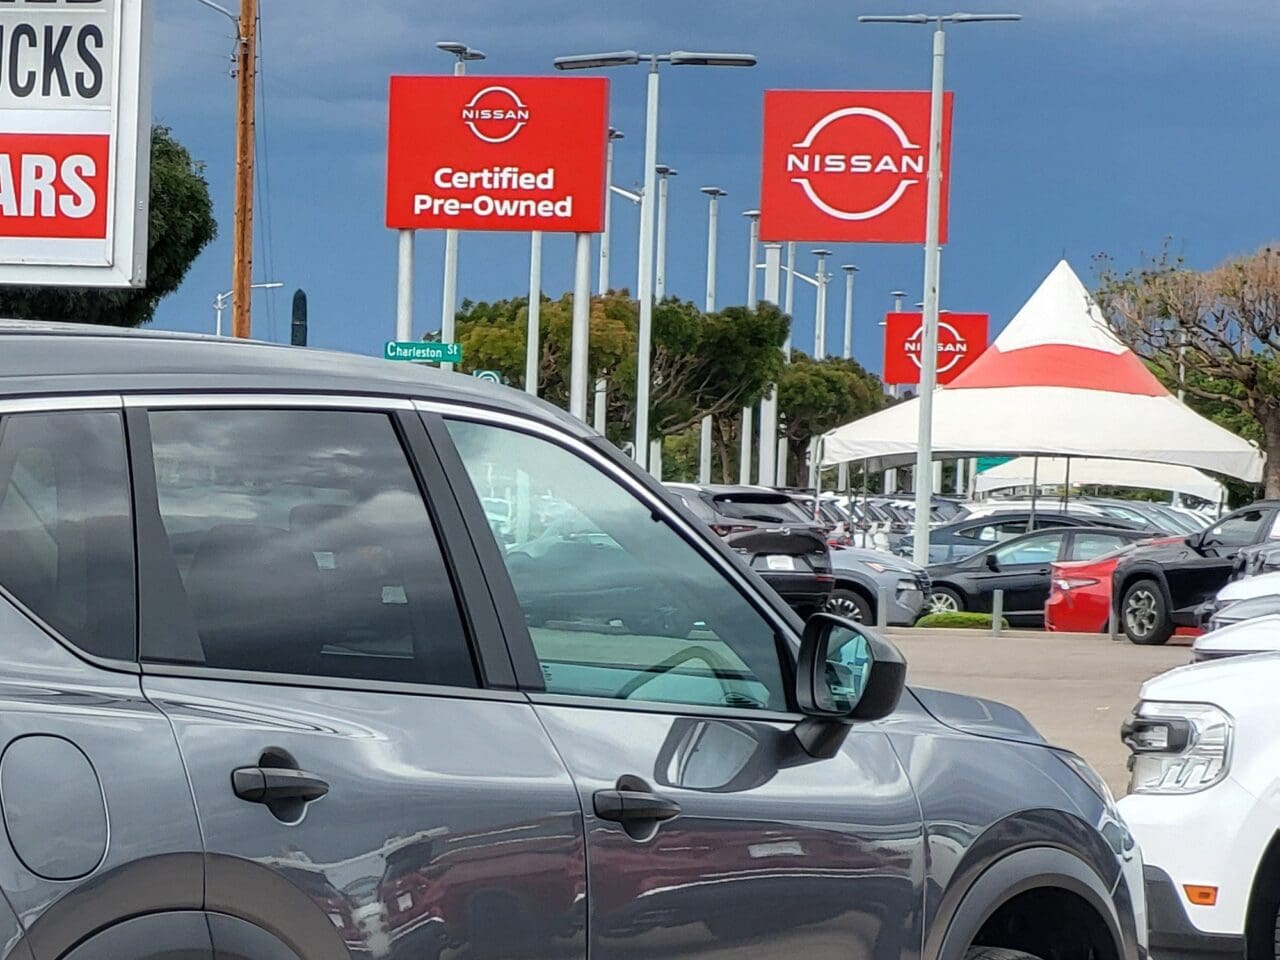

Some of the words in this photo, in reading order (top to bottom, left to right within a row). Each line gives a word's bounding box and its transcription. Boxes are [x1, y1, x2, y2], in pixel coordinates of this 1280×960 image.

[462, 109, 529, 120] NISSAN
[787, 154, 924, 173] NISSAN
[434, 167, 554, 189] Certified
[414, 194, 572, 217] Pre-Owned
[387, 342, 442, 358] Charleston
[447, 344, 457, 355] St
[904, 342, 967, 352] NISAN
